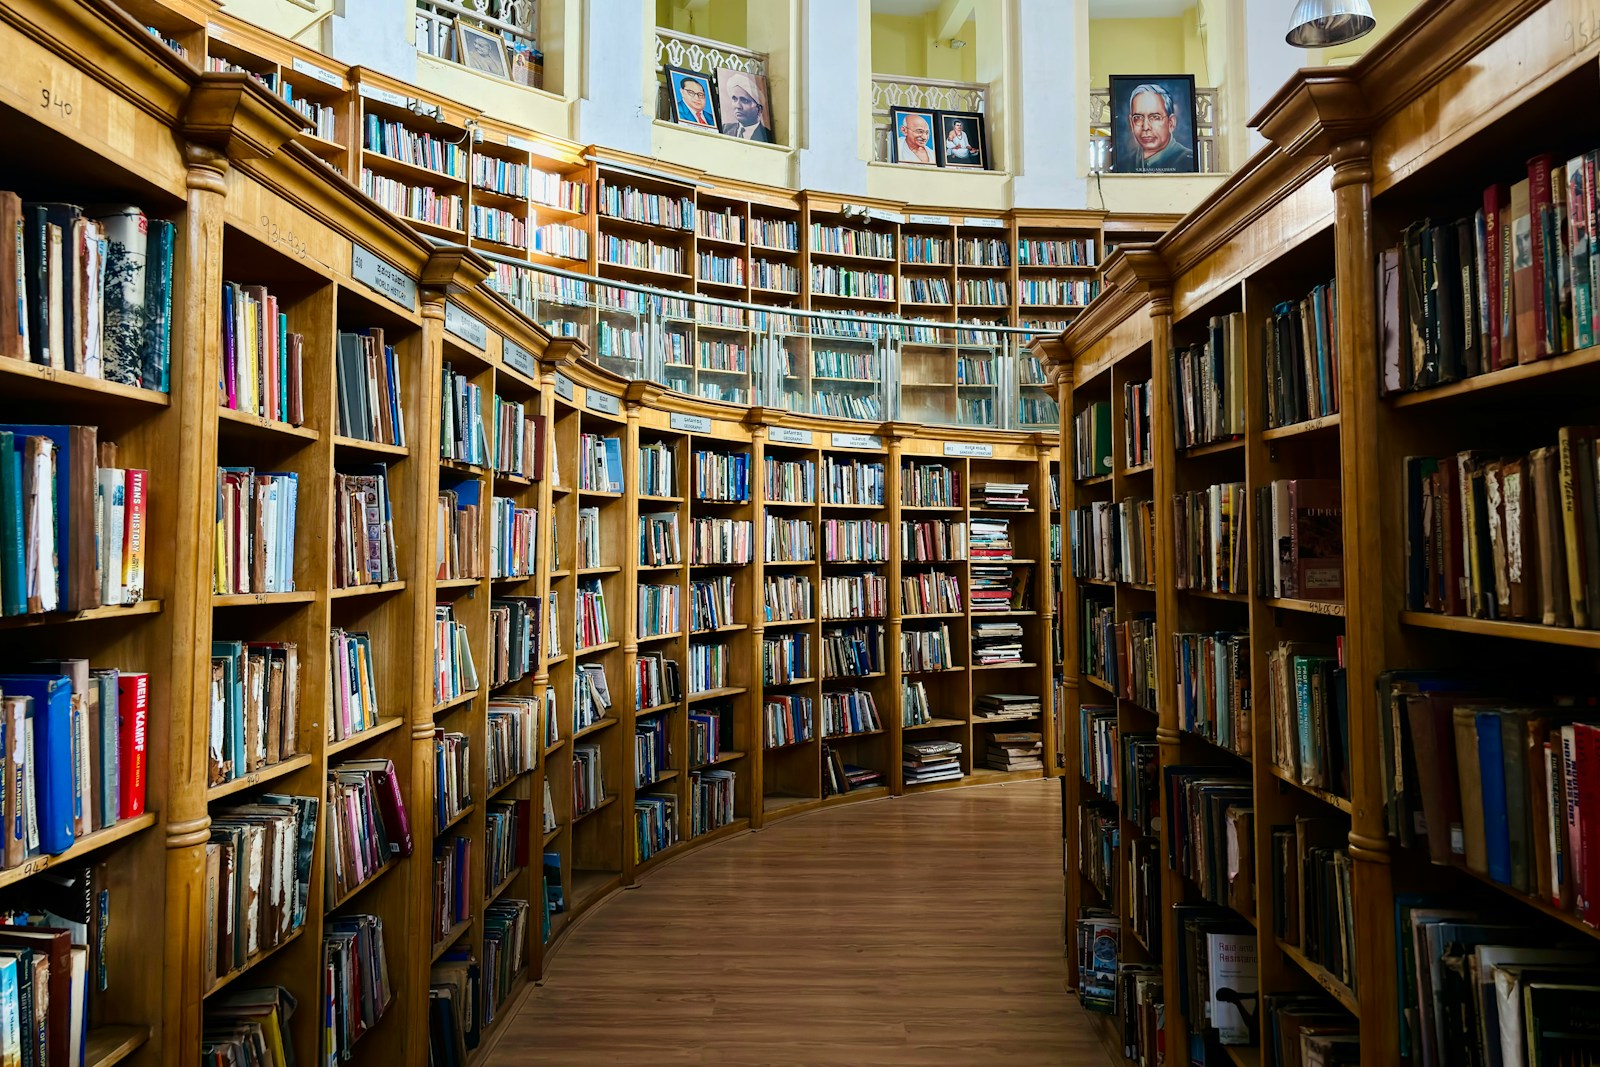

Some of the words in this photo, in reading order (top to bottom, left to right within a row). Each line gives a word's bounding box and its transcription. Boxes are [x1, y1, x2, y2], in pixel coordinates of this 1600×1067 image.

[41, 88, 73, 118] 940
[1536, 160, 1546, 195] INDIA
[375, 276, 390, 292] WORLD
[390, 286, 407, 302] HISTORY
[133, 473, 142, 505] TITANS
[1308, 508, 1343, 517] UPRI
[132, 513, 141, 552] HISTORY
[137, 677, 147, 709] MEIN
[134, 710, 146, 752] KAMPF
[1563, 739, 1573, 776] INDIAN
[1566, 777, 1576, 828] HISTORY
[24, 855, 50, 875] 943
[1219, 942, 1237, 951] Raid
[40, 1033, 45, 1042] OF
